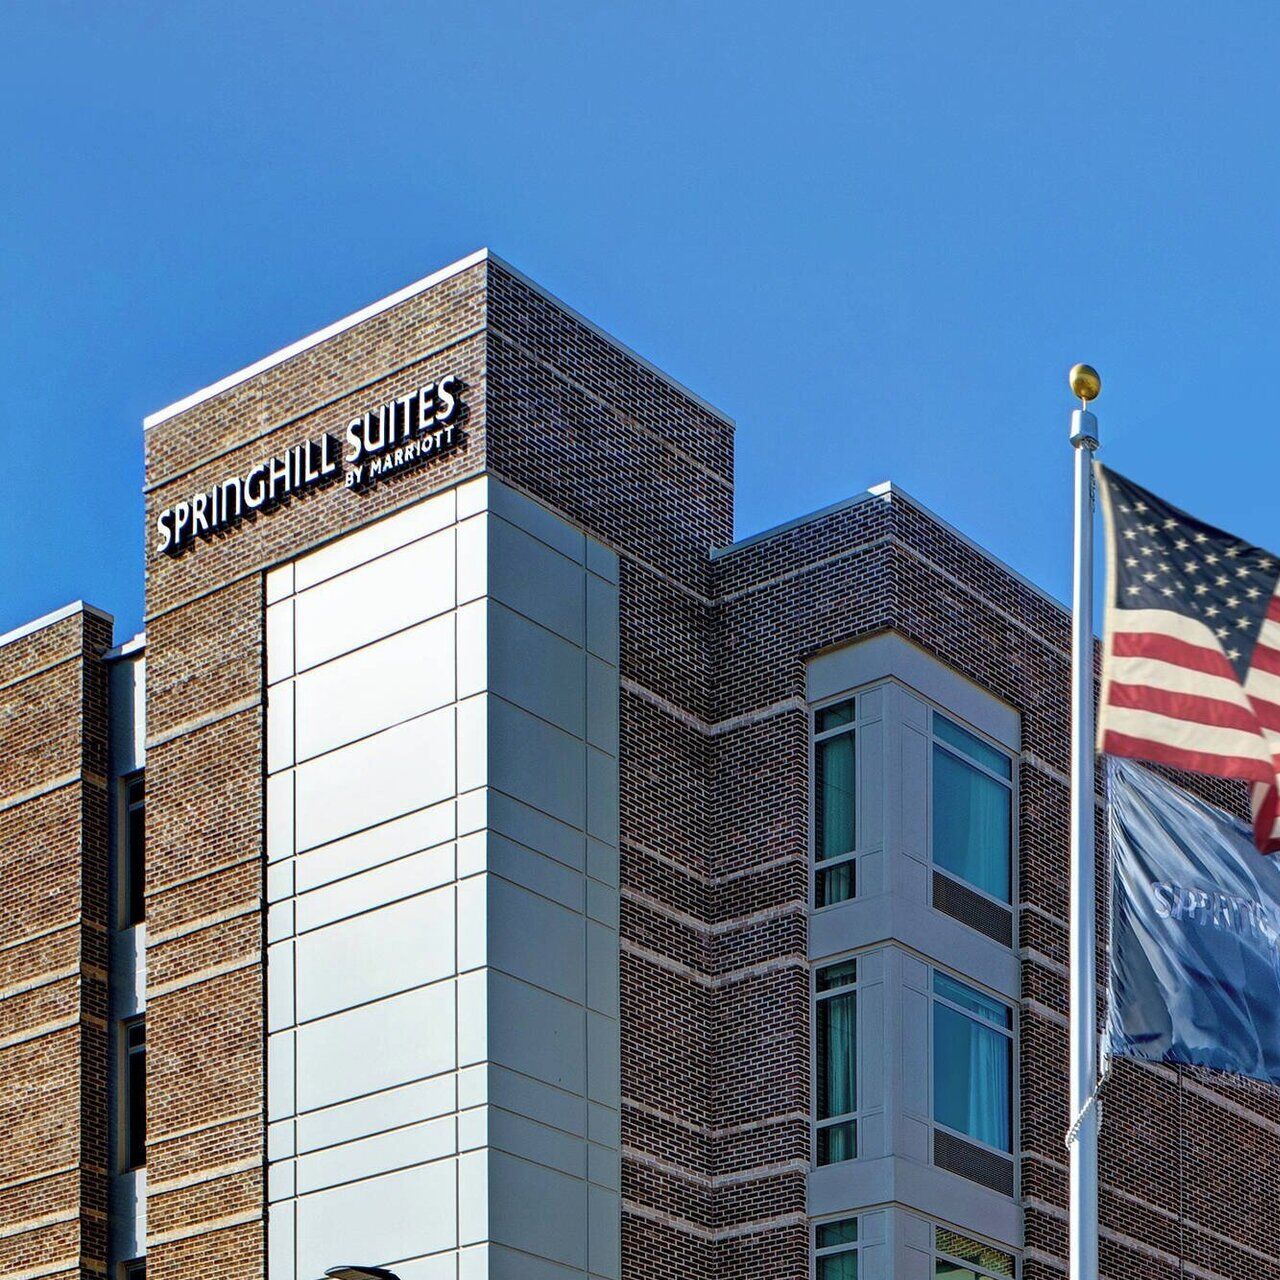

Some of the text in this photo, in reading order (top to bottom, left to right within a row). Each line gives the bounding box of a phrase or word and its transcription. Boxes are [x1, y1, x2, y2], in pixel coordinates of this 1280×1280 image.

[156, 374, 457, 552] SPRINGHILL SUITES
[344, 424, 455, 488] BY MARRIOTT
